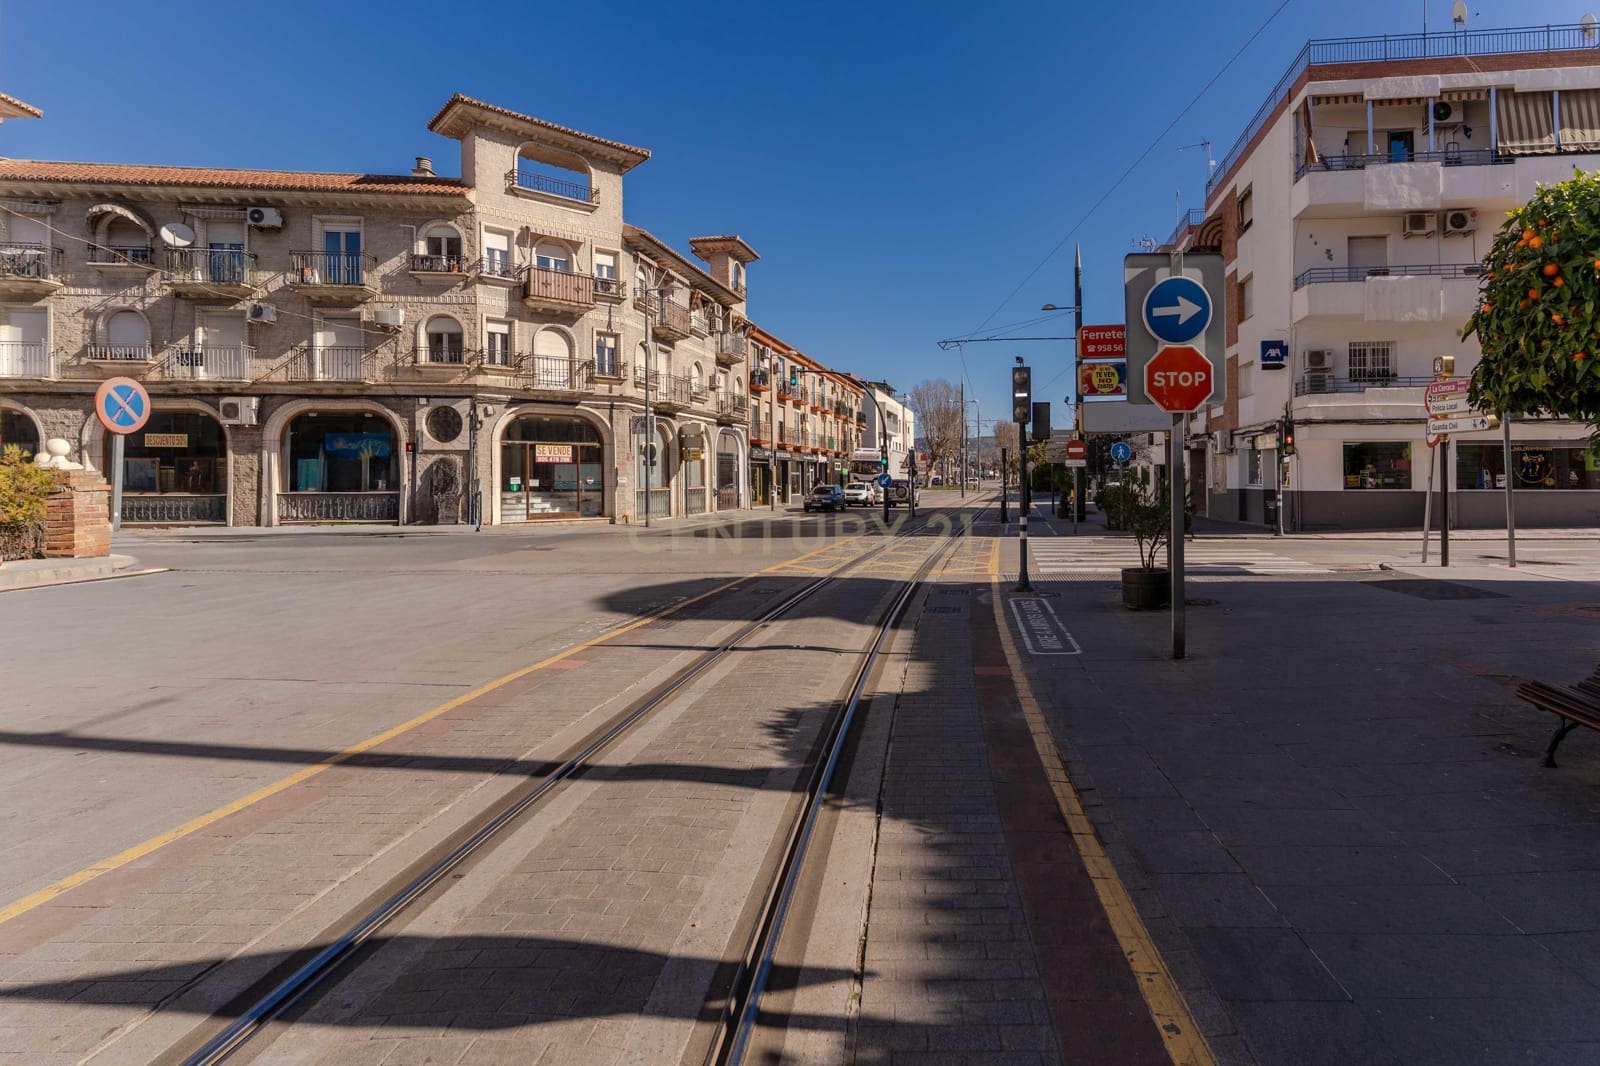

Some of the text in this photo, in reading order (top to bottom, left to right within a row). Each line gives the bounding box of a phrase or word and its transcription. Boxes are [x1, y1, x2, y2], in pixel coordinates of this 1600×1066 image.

[1097, 344, 1112, 352] 958
[1264, 348, 1281, 357] AXA
[1153, 371, 1206, 387] STOP
[1446, 402, 1457, 411] Local
[1432, 422, 1448, 431] Guardia
[537, 446, 571, 455] SE VENDE
